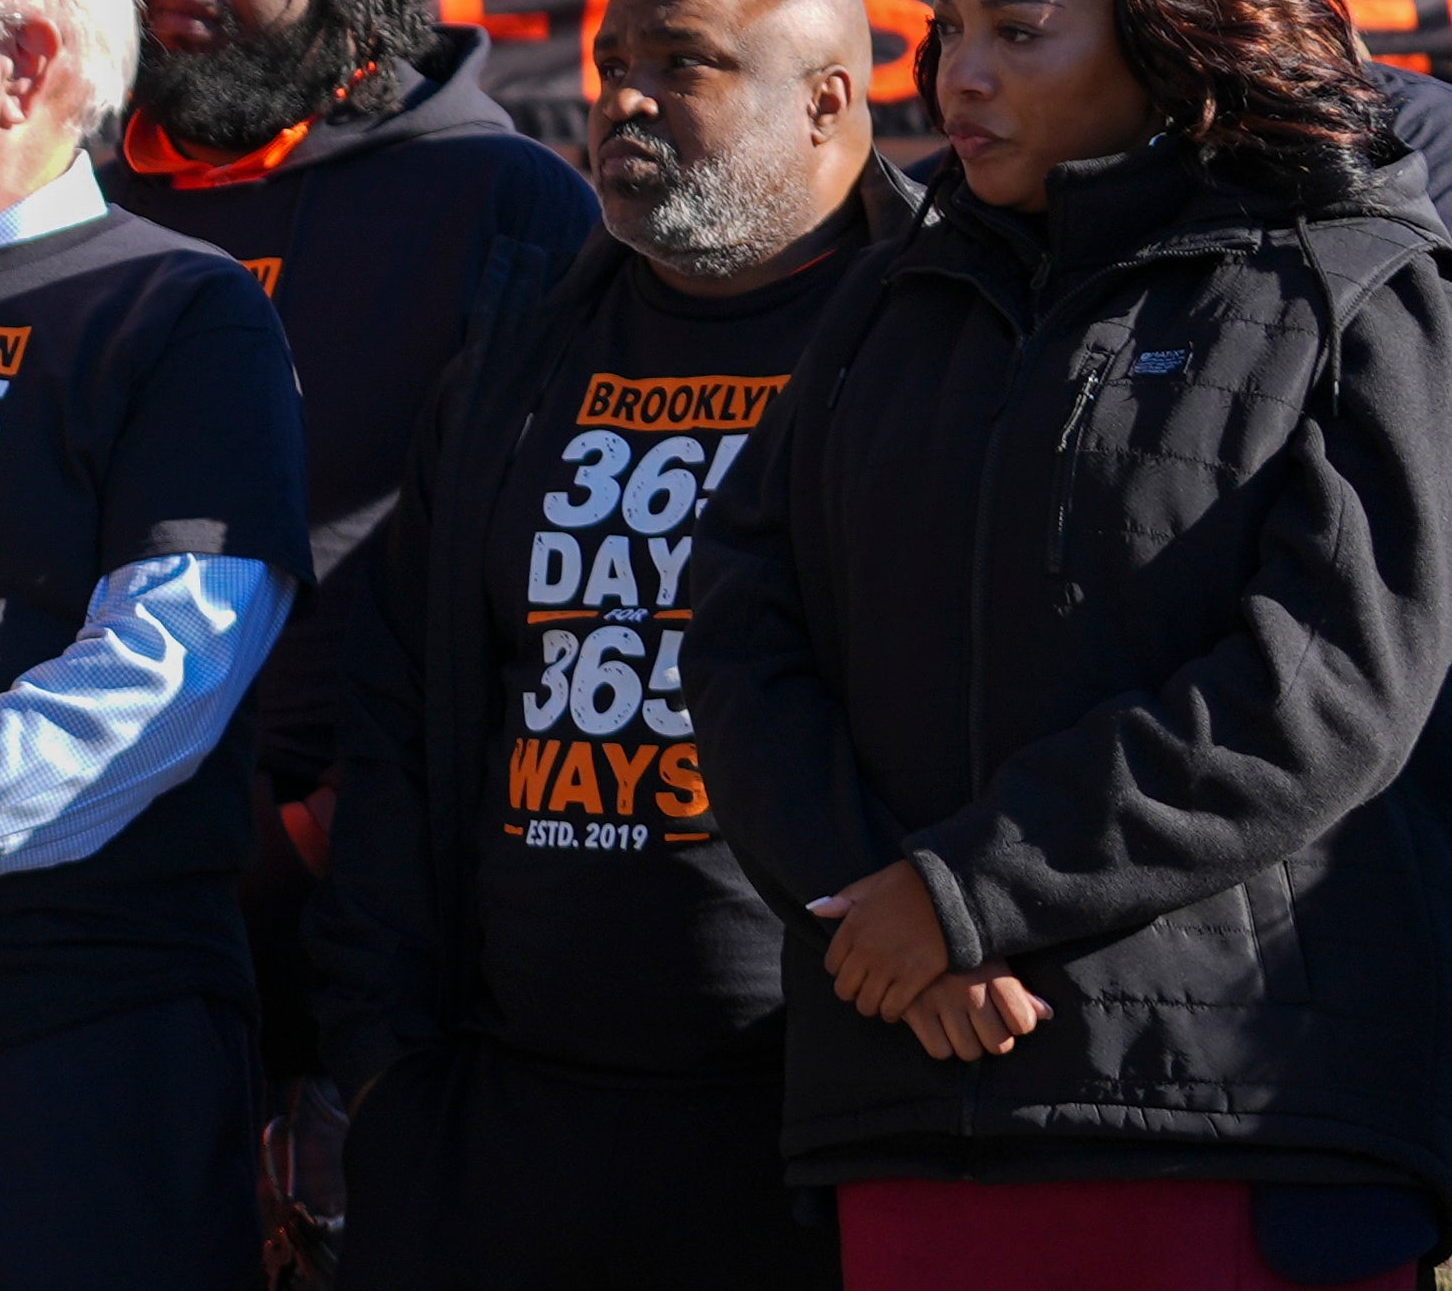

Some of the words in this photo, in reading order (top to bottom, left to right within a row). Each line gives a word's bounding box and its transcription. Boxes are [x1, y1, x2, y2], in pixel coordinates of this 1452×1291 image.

[528, 532, 692, 607] DAY
[508, 738, 709, 817] WAYS
[526, 819, 579, 848] ESTD.
[585, 822, 648, 851] 2019
